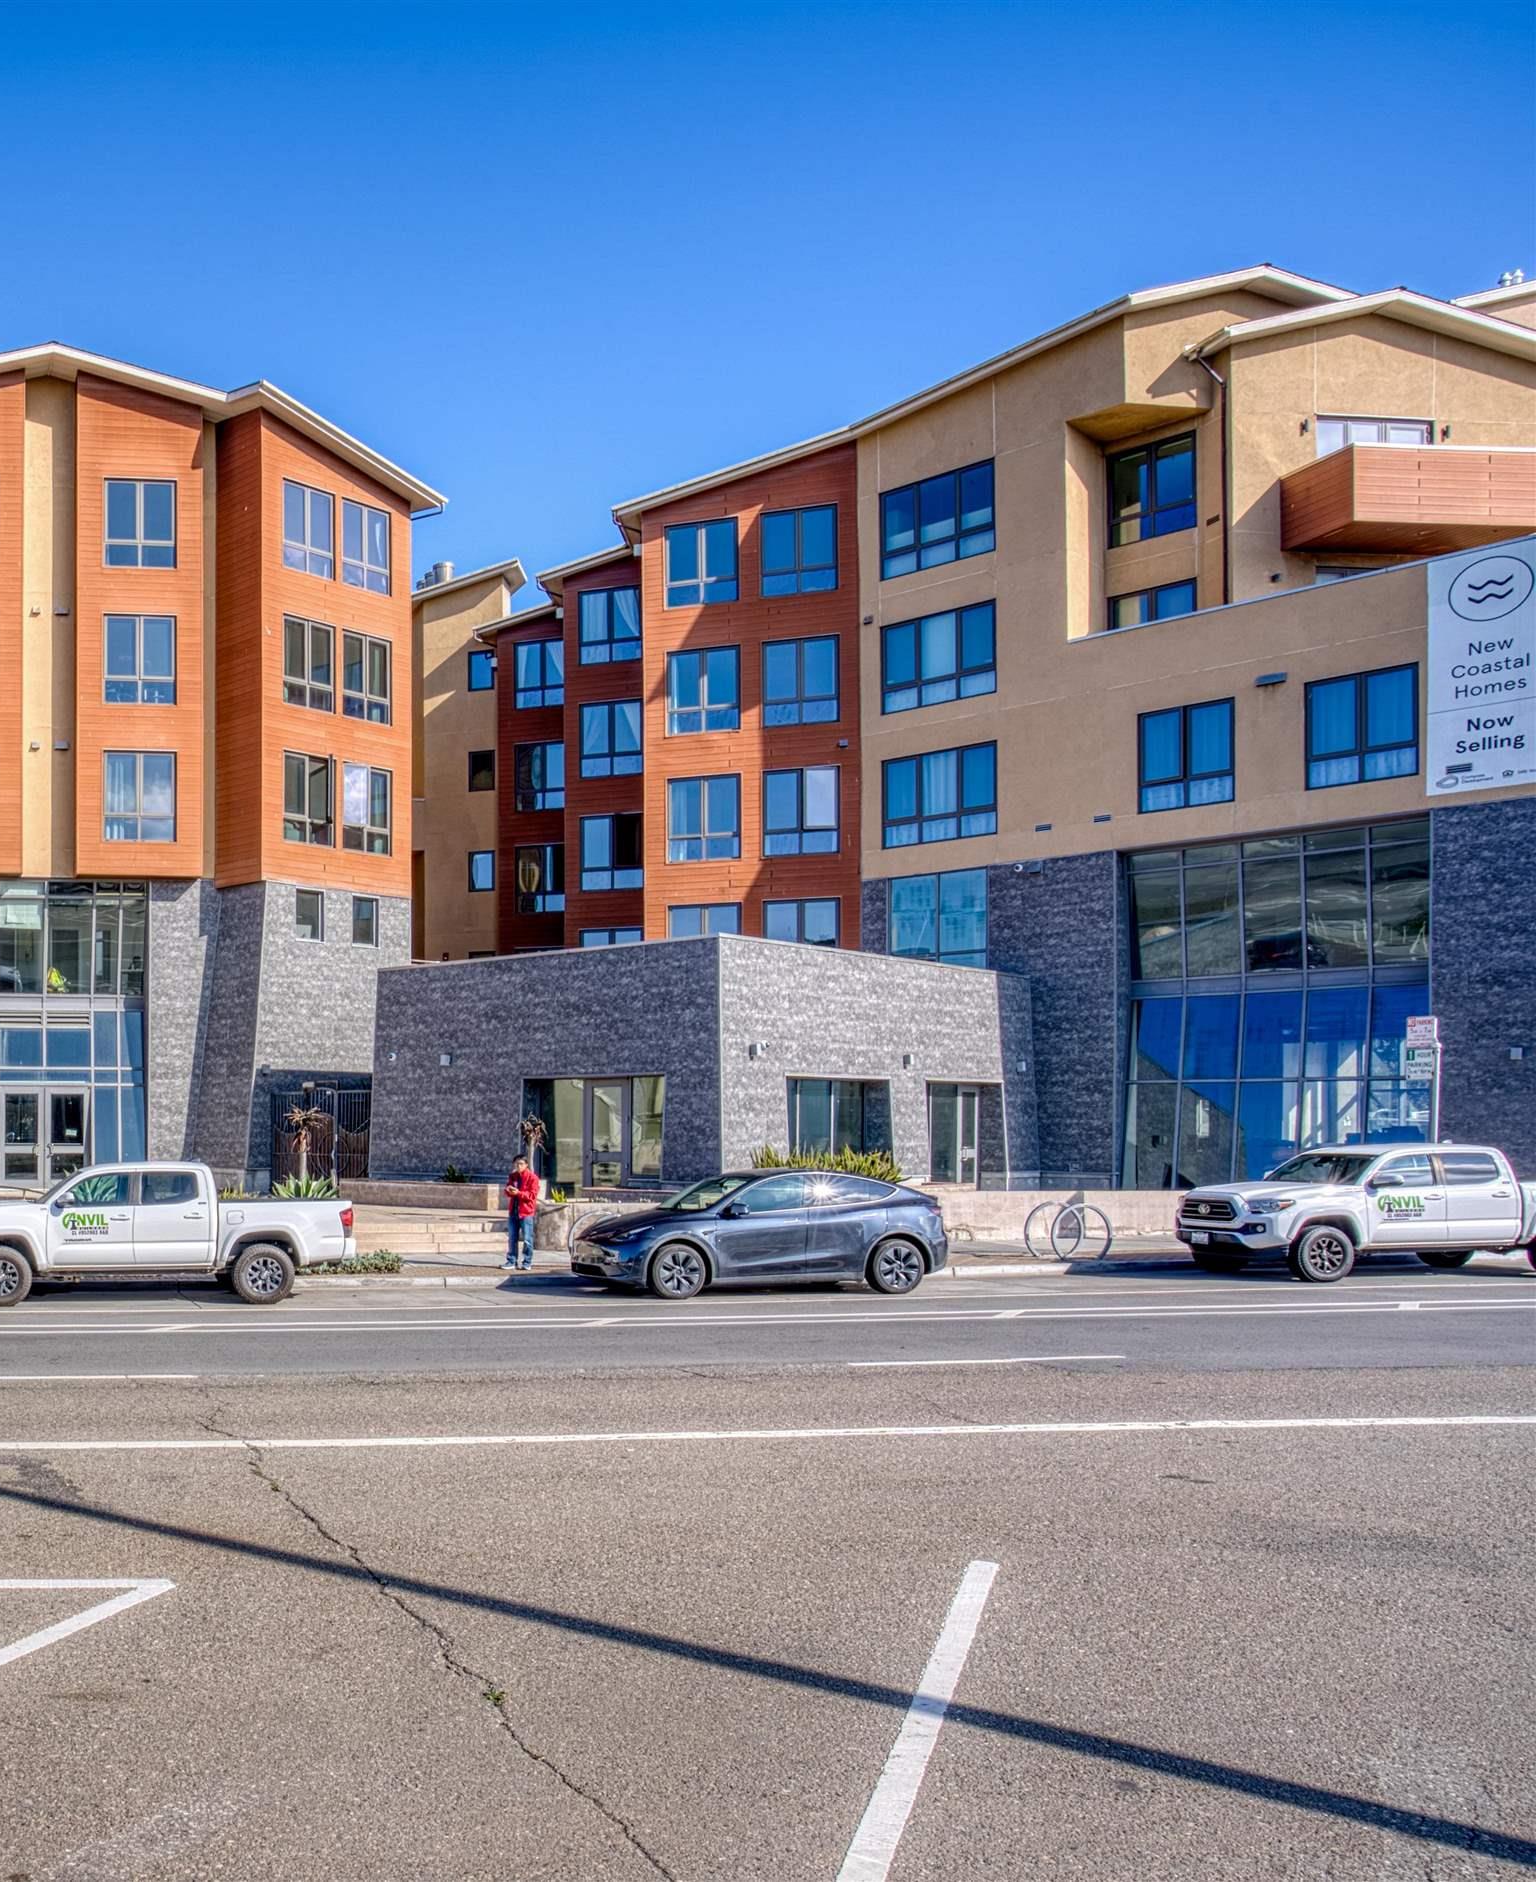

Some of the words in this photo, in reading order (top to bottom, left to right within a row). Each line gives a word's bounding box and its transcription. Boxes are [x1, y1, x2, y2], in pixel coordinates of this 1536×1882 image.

[1468, 637, 1514, 656] New
[1451, 653, 1530, 679] Coastal
[1455, 677, 1527, 699] Homes
[1466, 715, 1514, 732] Now
[1456, 734, 1525, 754] Selling
[1378, 1195, 1424, 1211] ANVIL
[62, 1213, 109, 1229] ANVIL
